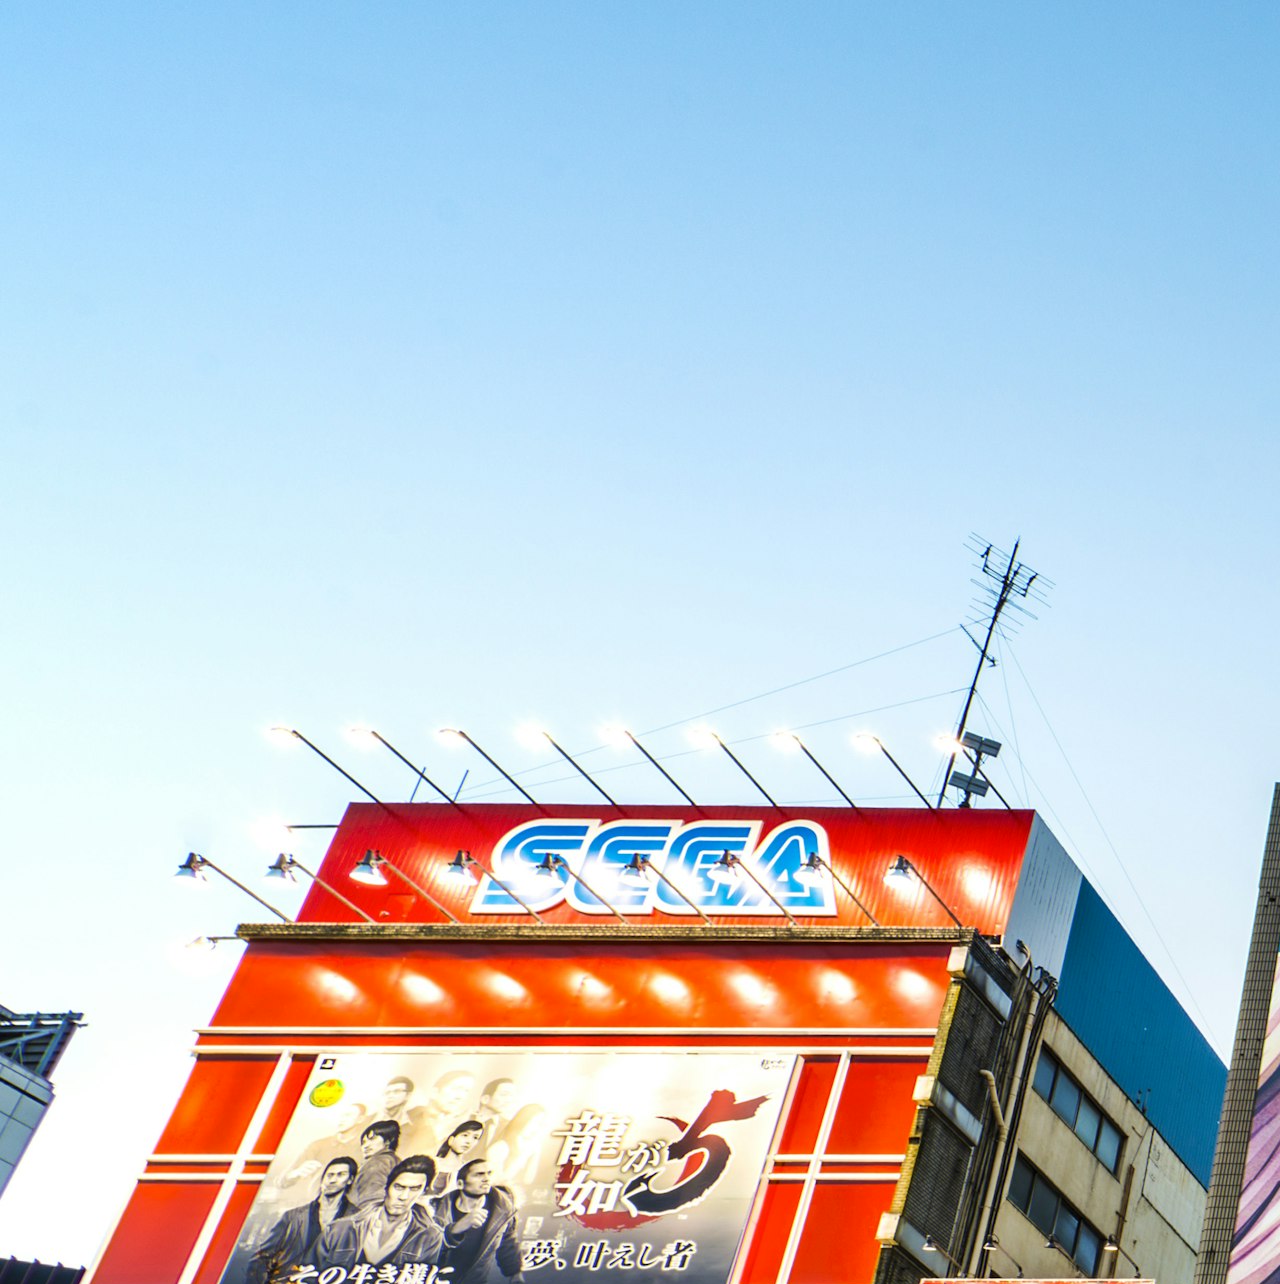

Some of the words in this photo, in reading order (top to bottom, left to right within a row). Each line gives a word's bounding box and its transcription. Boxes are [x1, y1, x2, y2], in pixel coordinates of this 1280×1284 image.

[474, 820, 833, 915] SEGA
[522, 1240, 697, 1271] 夢、叶えし者
